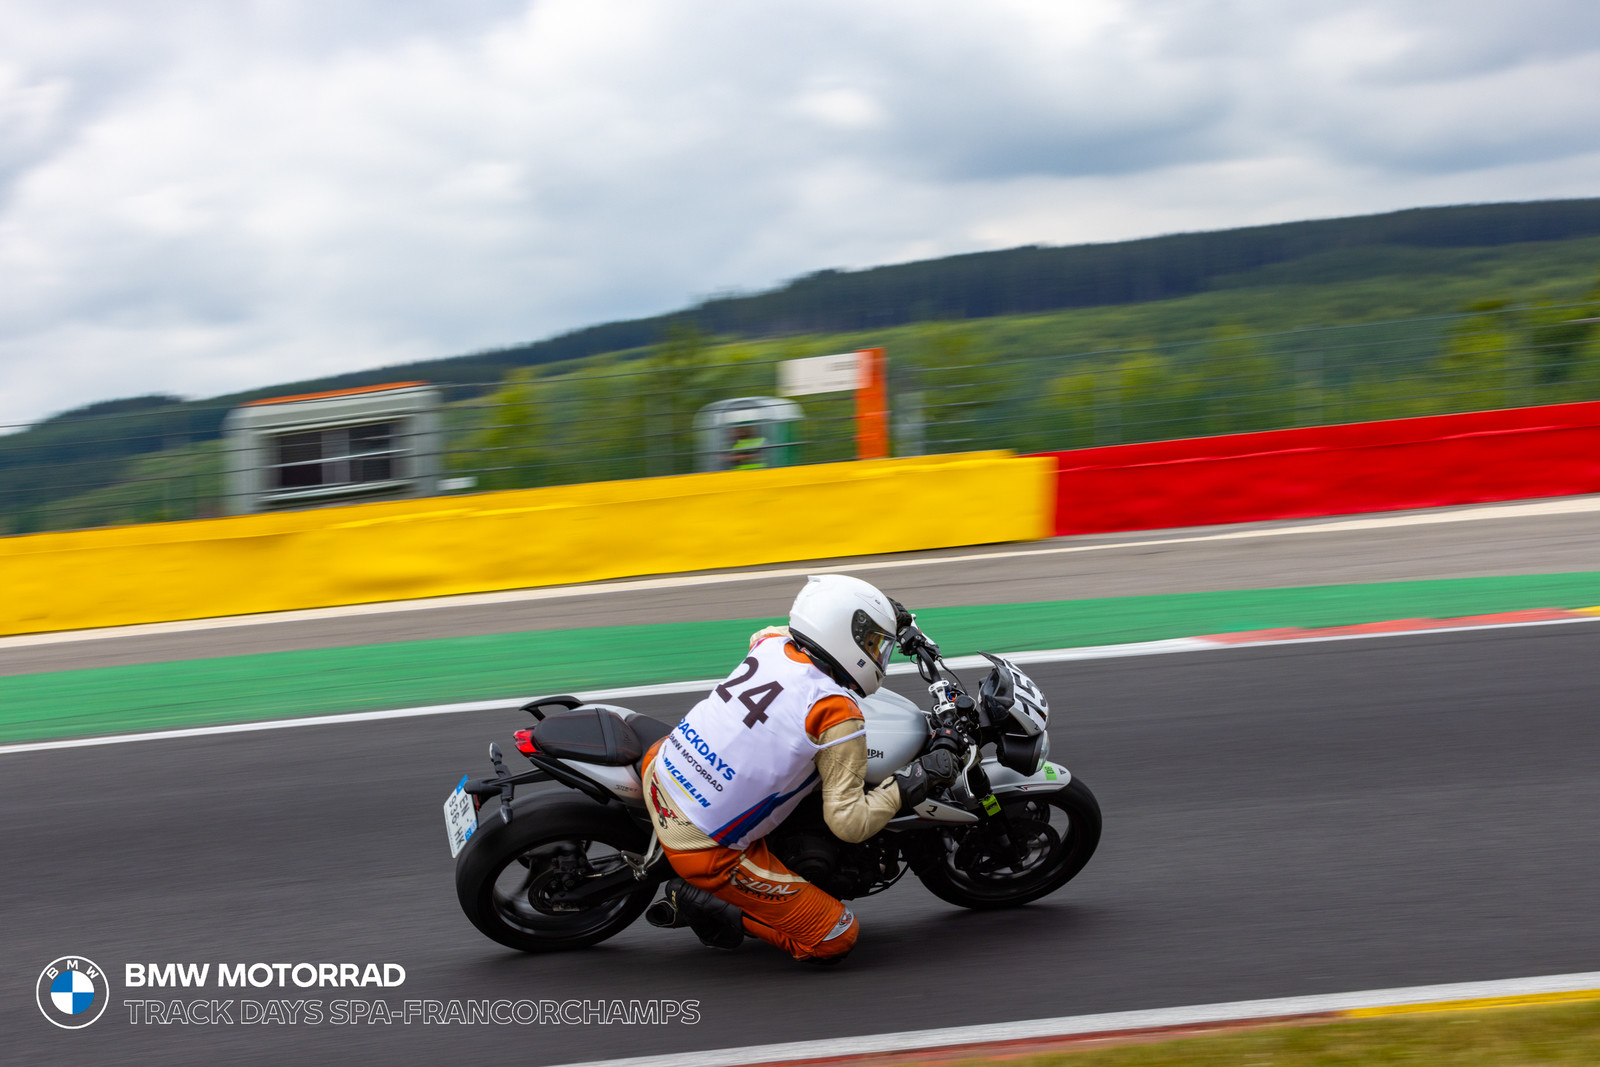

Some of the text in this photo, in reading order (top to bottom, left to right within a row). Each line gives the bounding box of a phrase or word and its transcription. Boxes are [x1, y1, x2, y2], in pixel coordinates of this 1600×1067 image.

[715, 656, 784, 729] 24
[664, 757, 712, 808] MICHELIN
[681, 749, 723, 793] MOTORRAD
